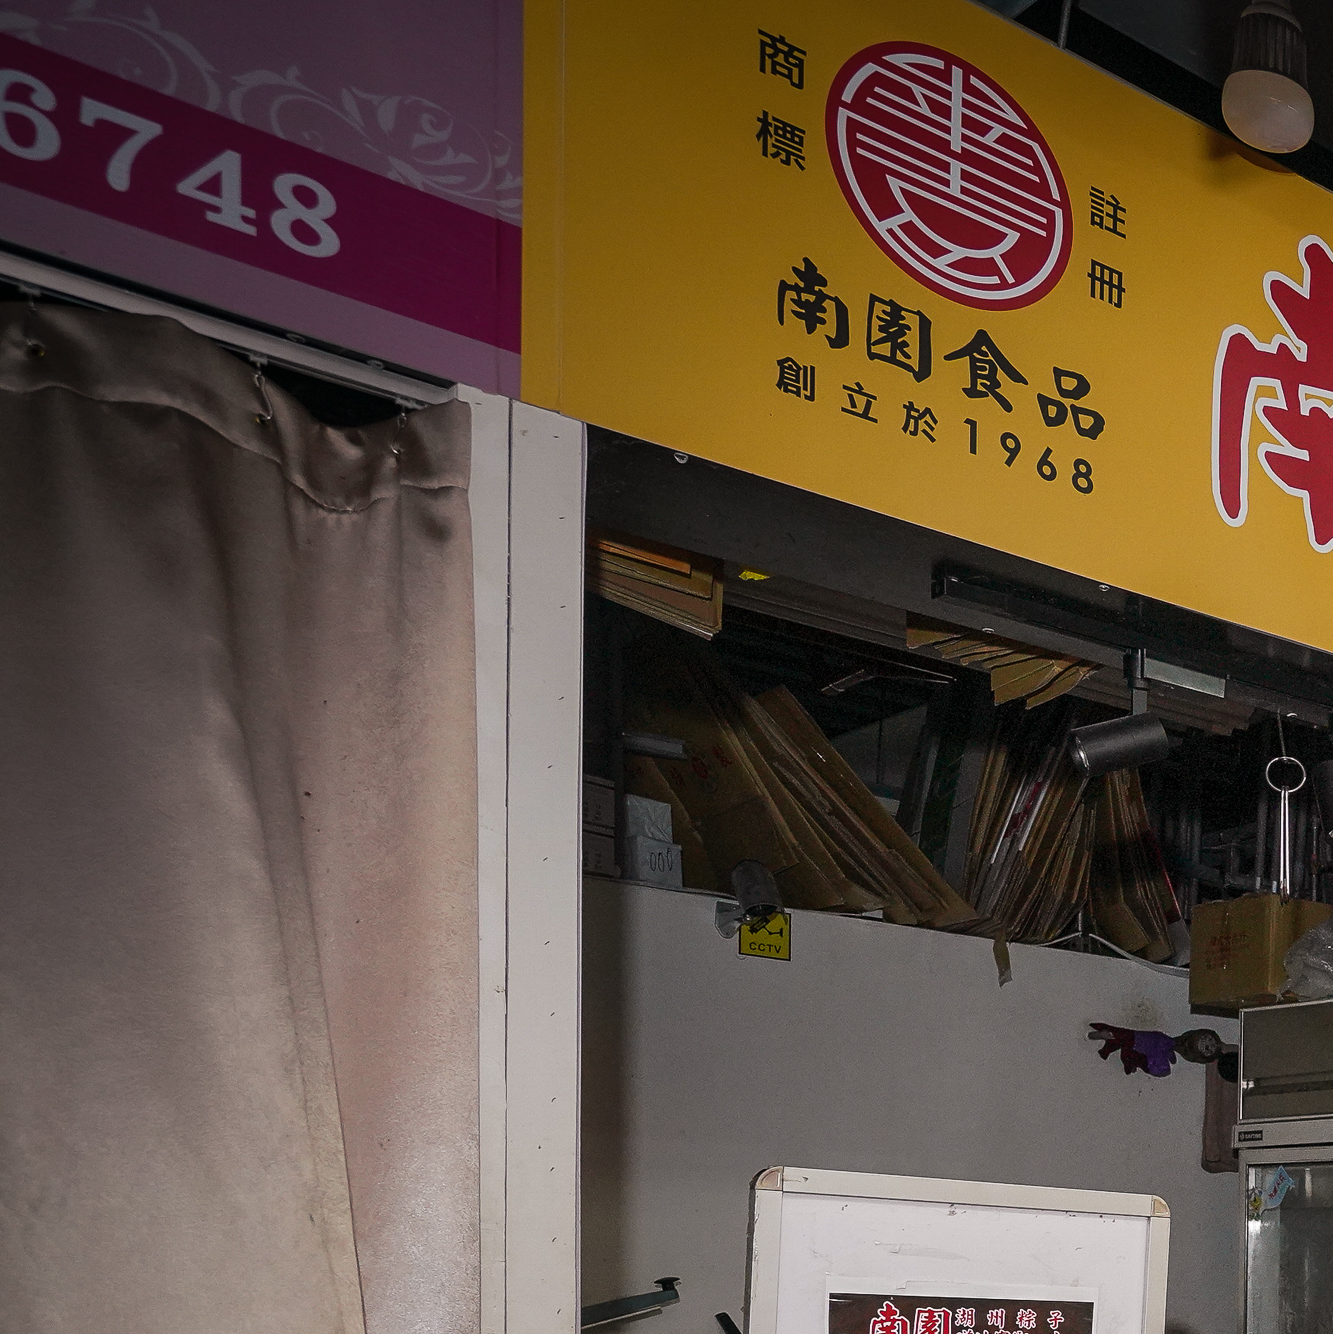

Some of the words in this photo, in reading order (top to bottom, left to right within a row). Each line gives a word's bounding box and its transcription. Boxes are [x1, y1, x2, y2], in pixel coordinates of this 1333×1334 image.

[0, 67, 340, 260] 6748
[755, 28, 808, 173] 商標
[1085, 185, 1129, 311] 註冊
[774, 257, 1107, 442] 南園食品
[774, 356, 1096, 495] 創立於1968
[748, 940, 784, 956] CCTV
[955, 1308, 1065, 1328] 湖州粽子
